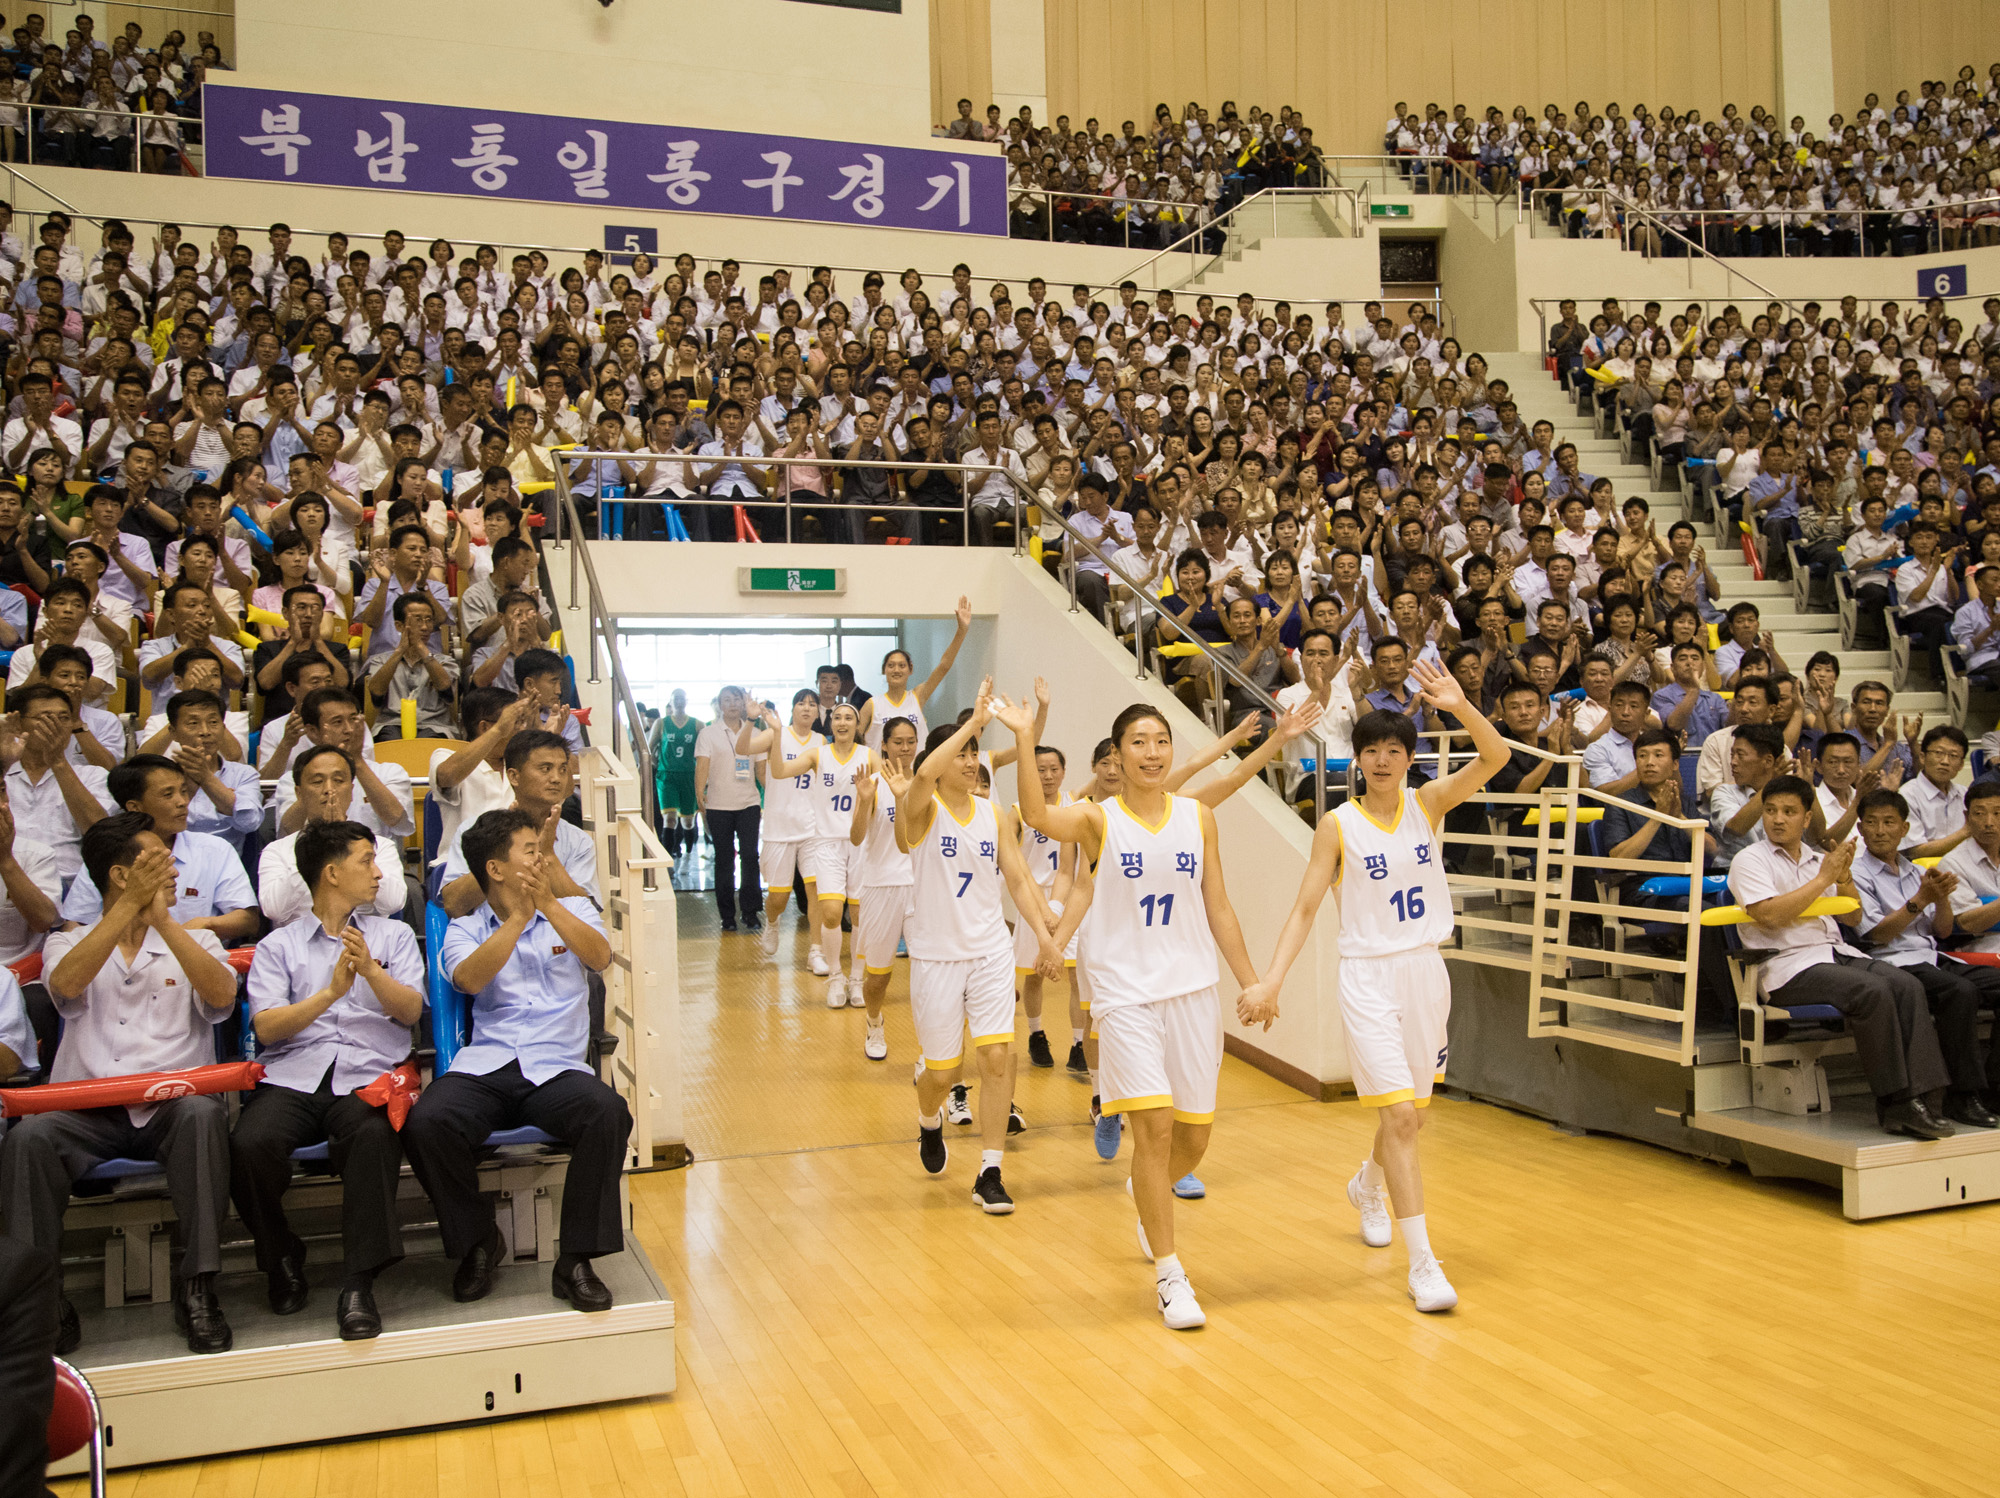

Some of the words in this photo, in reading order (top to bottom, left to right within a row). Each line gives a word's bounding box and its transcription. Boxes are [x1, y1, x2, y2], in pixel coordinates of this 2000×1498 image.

[624, 234, 640, 253] 5
[1934, 273, 1951, 295] 6
[676, 746, 684, 758] 9
[794, 773, 811, 790] 13
[831, 794, 852, 812] 10
[956, 872, 973, 898] 7
[1139, 893, 1174, 927] 11
[1389, 885, 1425, 922] 16
